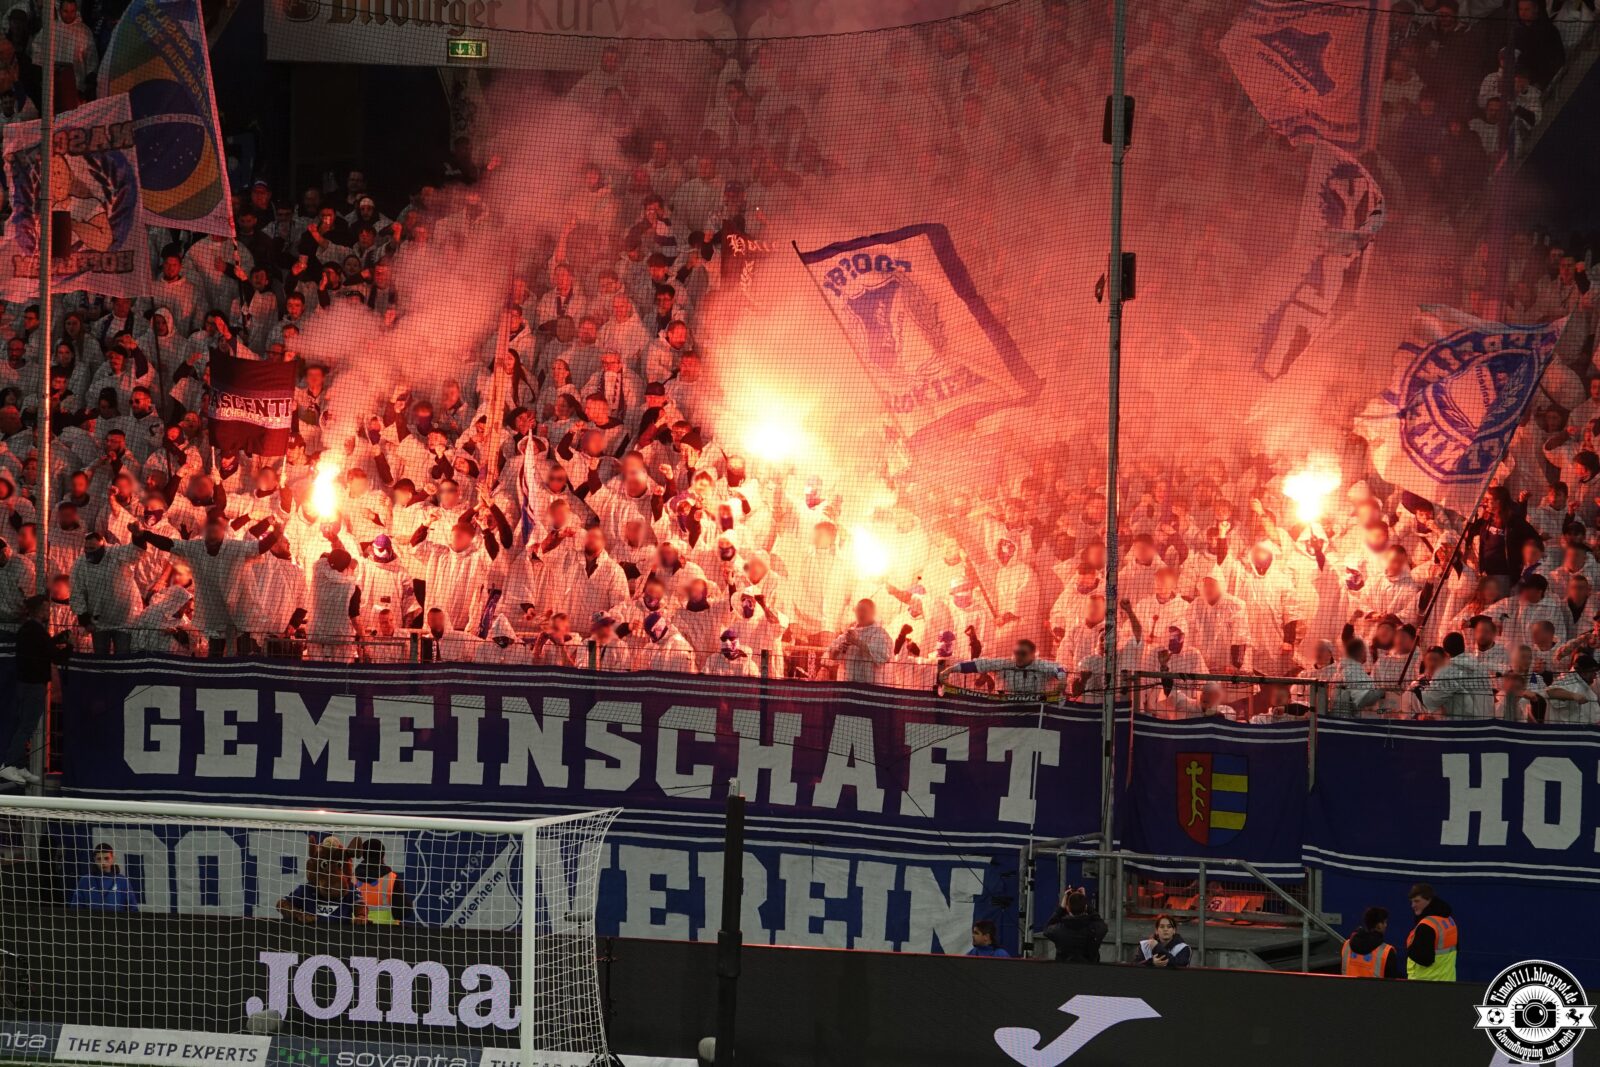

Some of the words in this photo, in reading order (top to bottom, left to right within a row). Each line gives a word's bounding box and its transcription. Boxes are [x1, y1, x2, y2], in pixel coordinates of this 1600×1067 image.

[526, 0, 640, 32] Kurv
[123, 685, 1060, 824] GEMEINSCHAFT
[1440, 752, 1600, 853] HO
[92, 828, 406, 918] DOR
[534, 838, 984, 955] VEREIN
[246, 951, 521, 1030] Joma
[68, 1037, 101, 1053] THE
[107, 1039, 140, 1056] SAP
[143, 1042, 177, 1058] BTP
[182, 1044, 258, 1063] EXPERTS
[336, 1051, 468, 1067] sovanta
